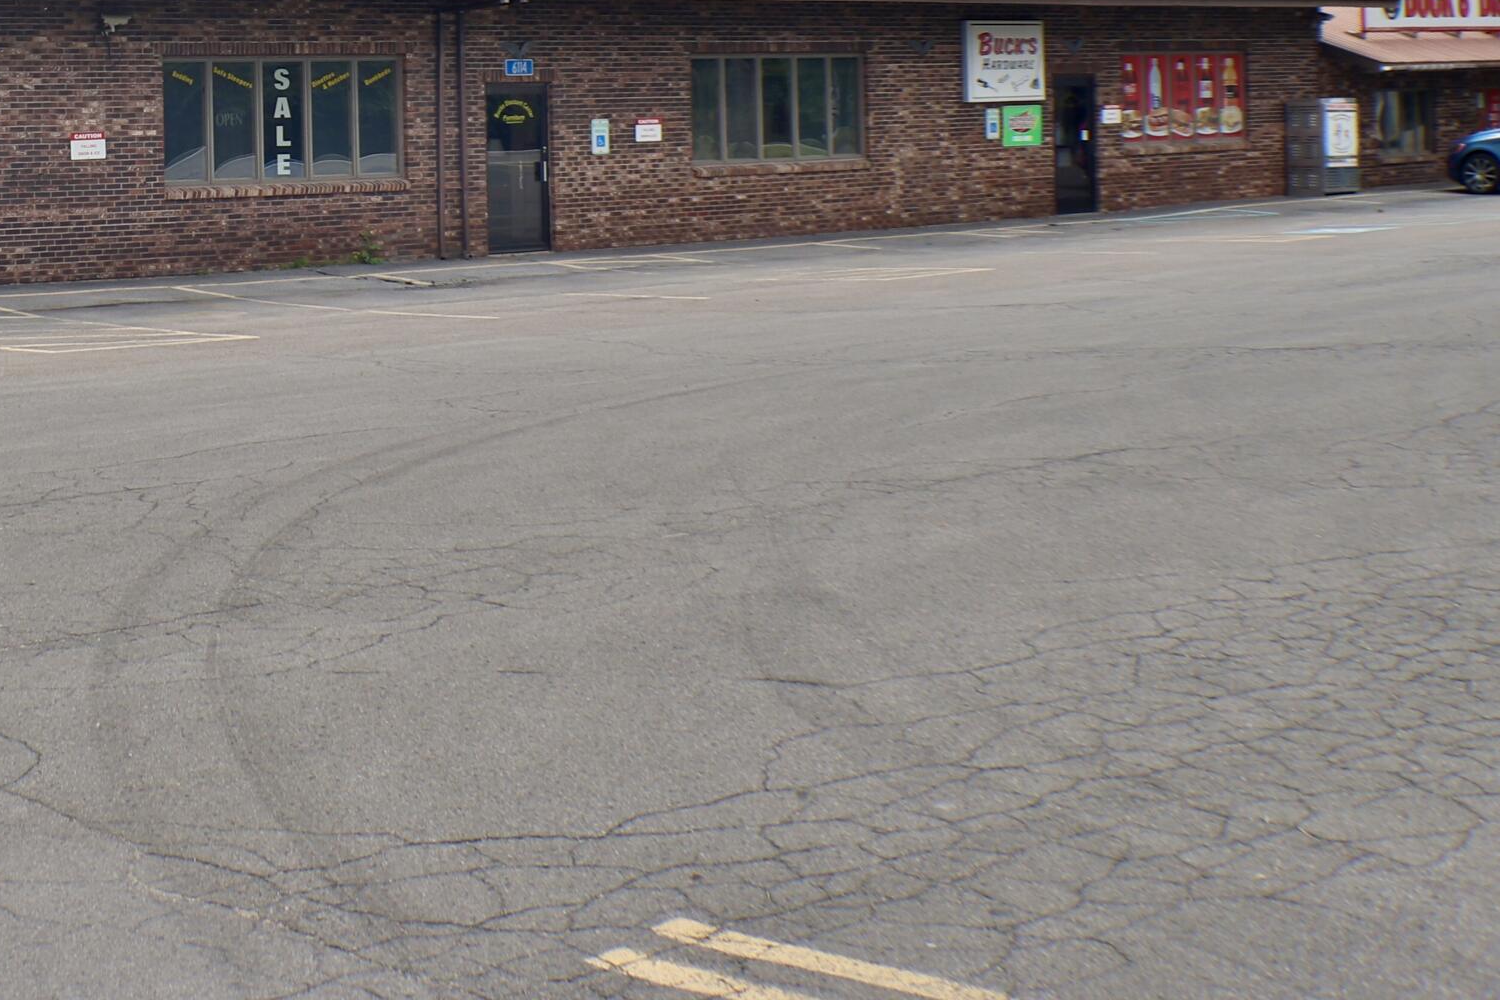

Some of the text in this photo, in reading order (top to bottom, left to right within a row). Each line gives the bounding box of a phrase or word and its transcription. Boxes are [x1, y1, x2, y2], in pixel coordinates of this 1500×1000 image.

[511, 61, 528, 74] 6114
[215, 112, 243, 128] OPEN
[274, 68, 292, 175] SALE
